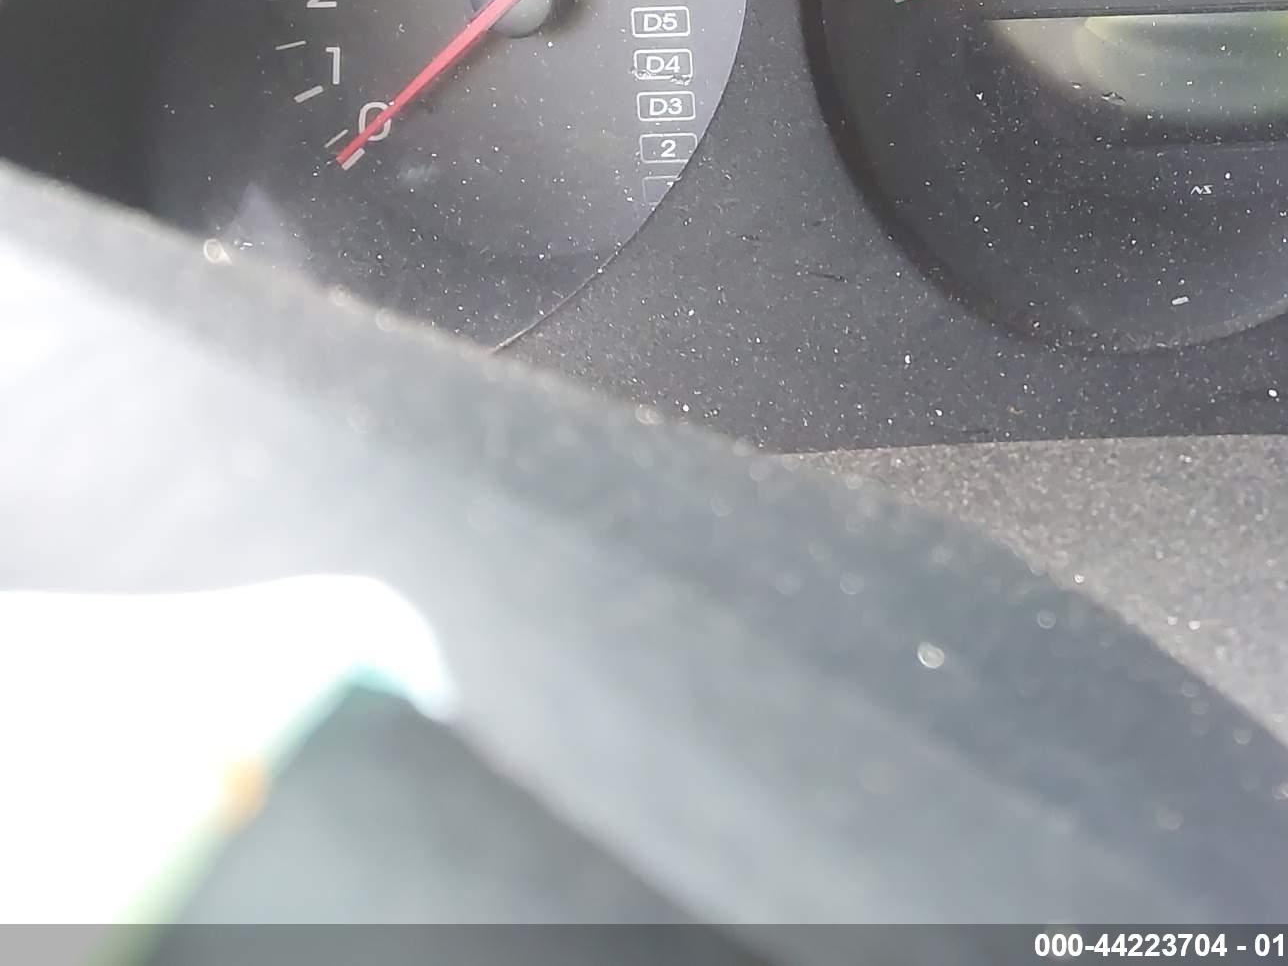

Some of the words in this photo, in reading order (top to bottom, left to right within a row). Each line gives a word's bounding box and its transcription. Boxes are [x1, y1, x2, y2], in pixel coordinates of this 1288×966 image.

[644, 13, 677, 31] D5
[326, 47, 340, 84] 1
[647, 56, 680, 73] D4
[650, 98, 682, 115] D3
[359, 102, 391, 140] 0
[661, 140, 676, 157] 2
